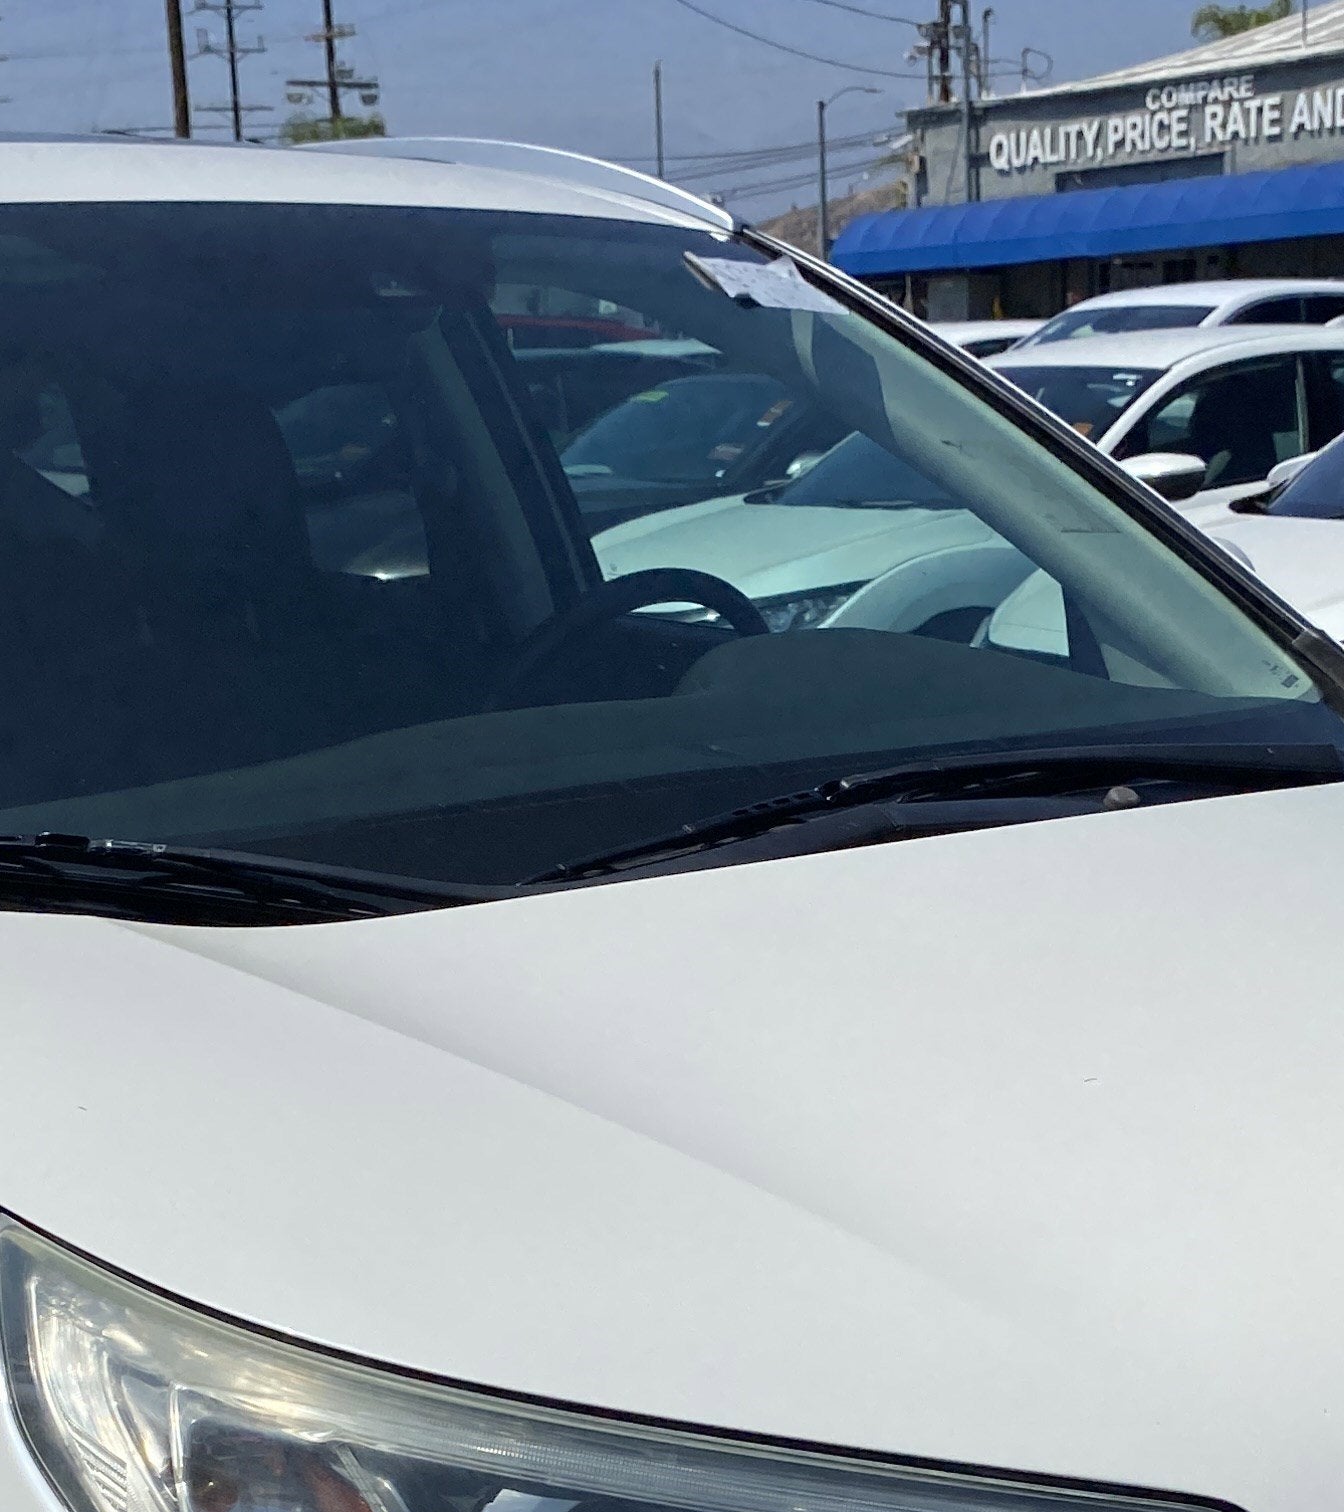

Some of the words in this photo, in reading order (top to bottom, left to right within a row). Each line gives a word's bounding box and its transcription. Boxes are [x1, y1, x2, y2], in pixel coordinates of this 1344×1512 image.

[1145, 75, 1254, 111] COMPARE
[989, 119, 1104, 170] QUALITY,
[1108, 108, 1196, 156] PRICE,
[1204, 97, 1281, 142] RATE
